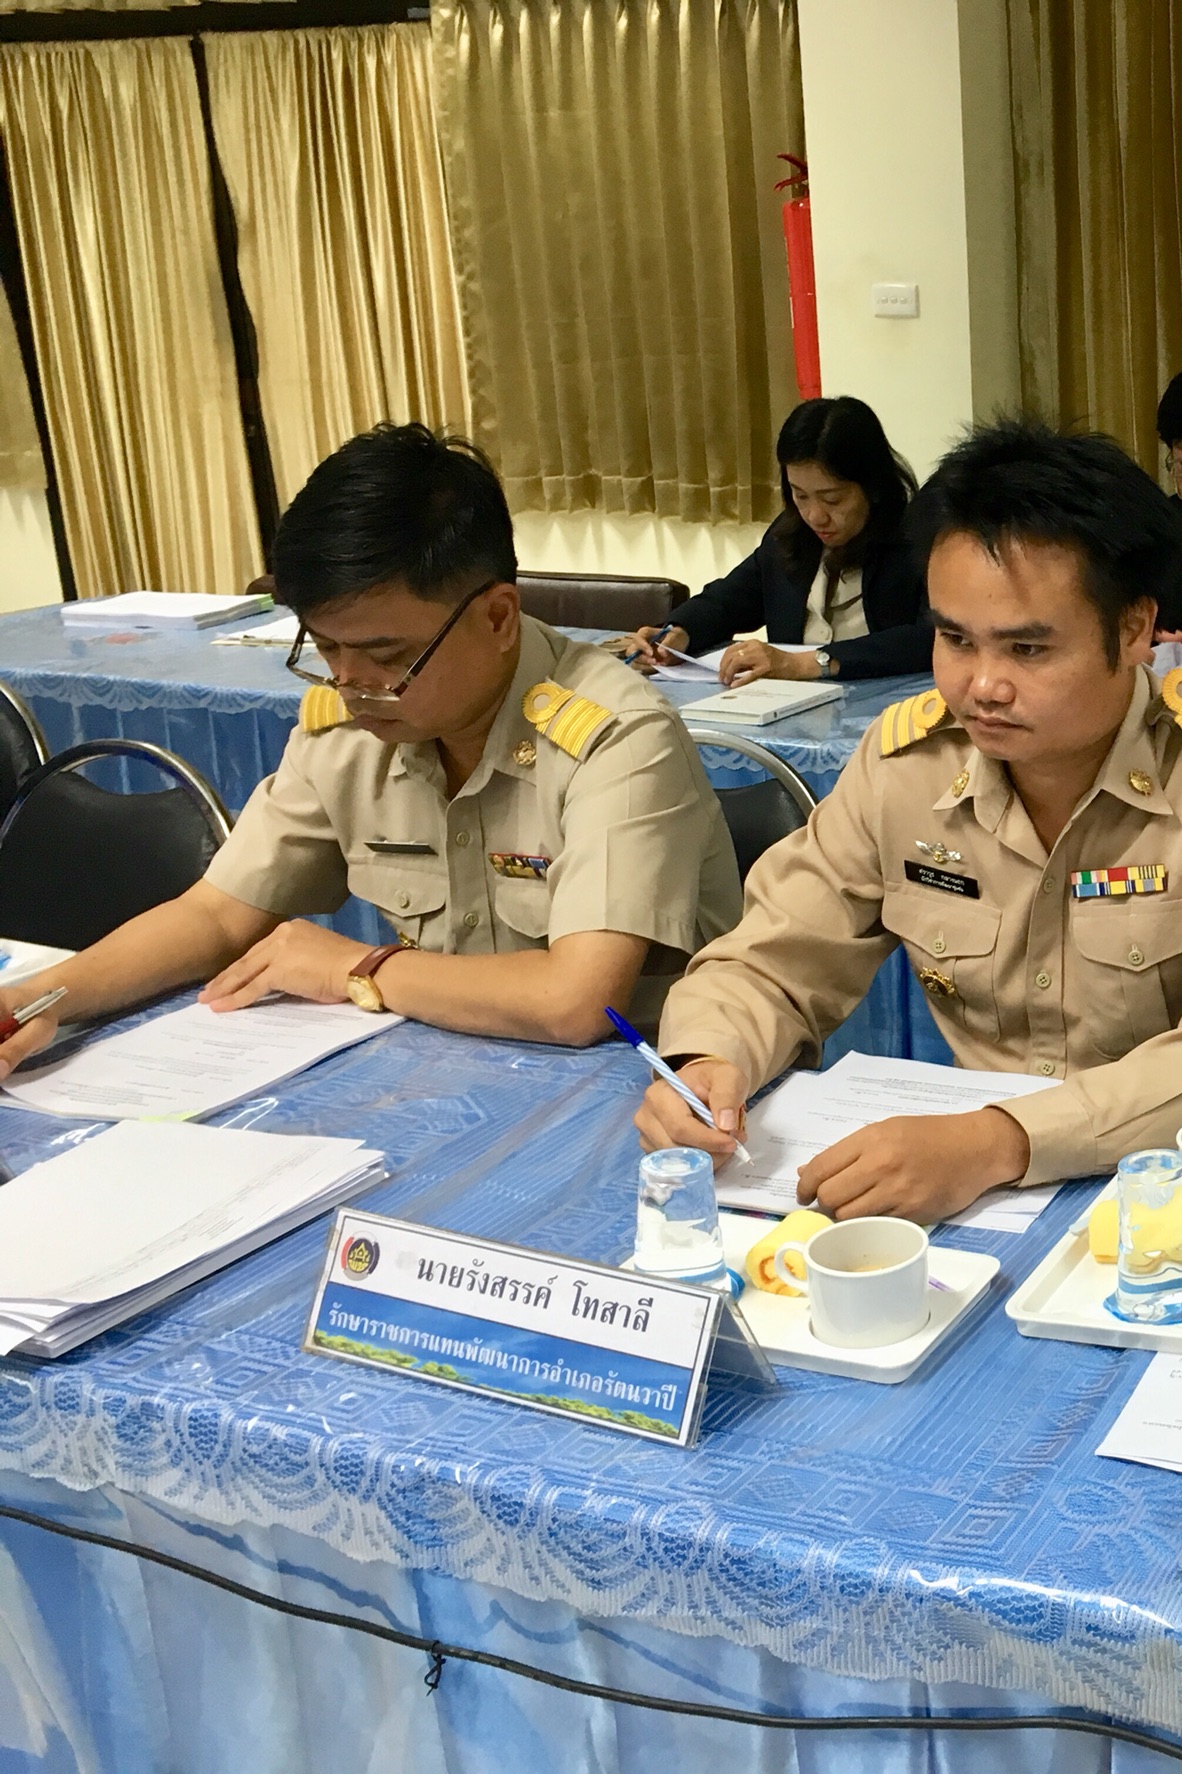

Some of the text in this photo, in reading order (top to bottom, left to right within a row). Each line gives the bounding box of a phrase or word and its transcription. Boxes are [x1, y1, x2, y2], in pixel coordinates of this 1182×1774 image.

[417, 1255, 654, 1334] นายรังสรรค์ โทสาลี
[327, 1302, 678, 1412] รักษาราชการแทนพัฒนาการอำเภอรัตนวาปี
